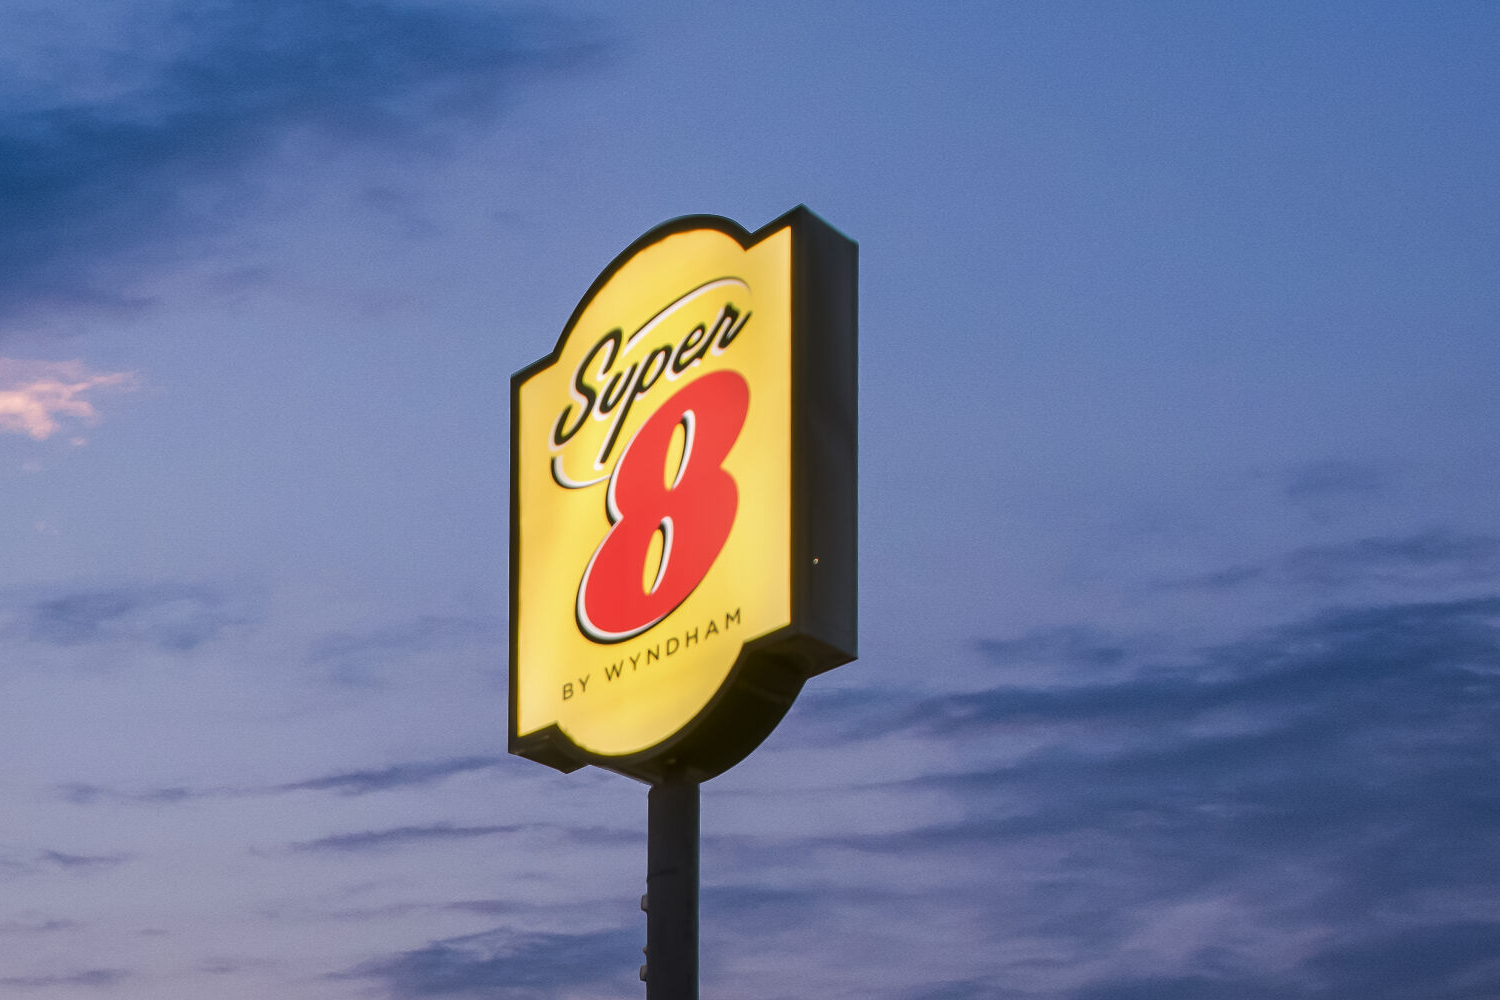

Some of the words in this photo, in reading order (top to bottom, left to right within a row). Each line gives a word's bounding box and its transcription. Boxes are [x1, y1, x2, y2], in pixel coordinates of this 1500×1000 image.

[551, 302, 752, 466] Super
[575, 369, 750, 643] 8
[563, 674, 590, 700] BY
[605, 608, 740, 681] WYNDHAM
